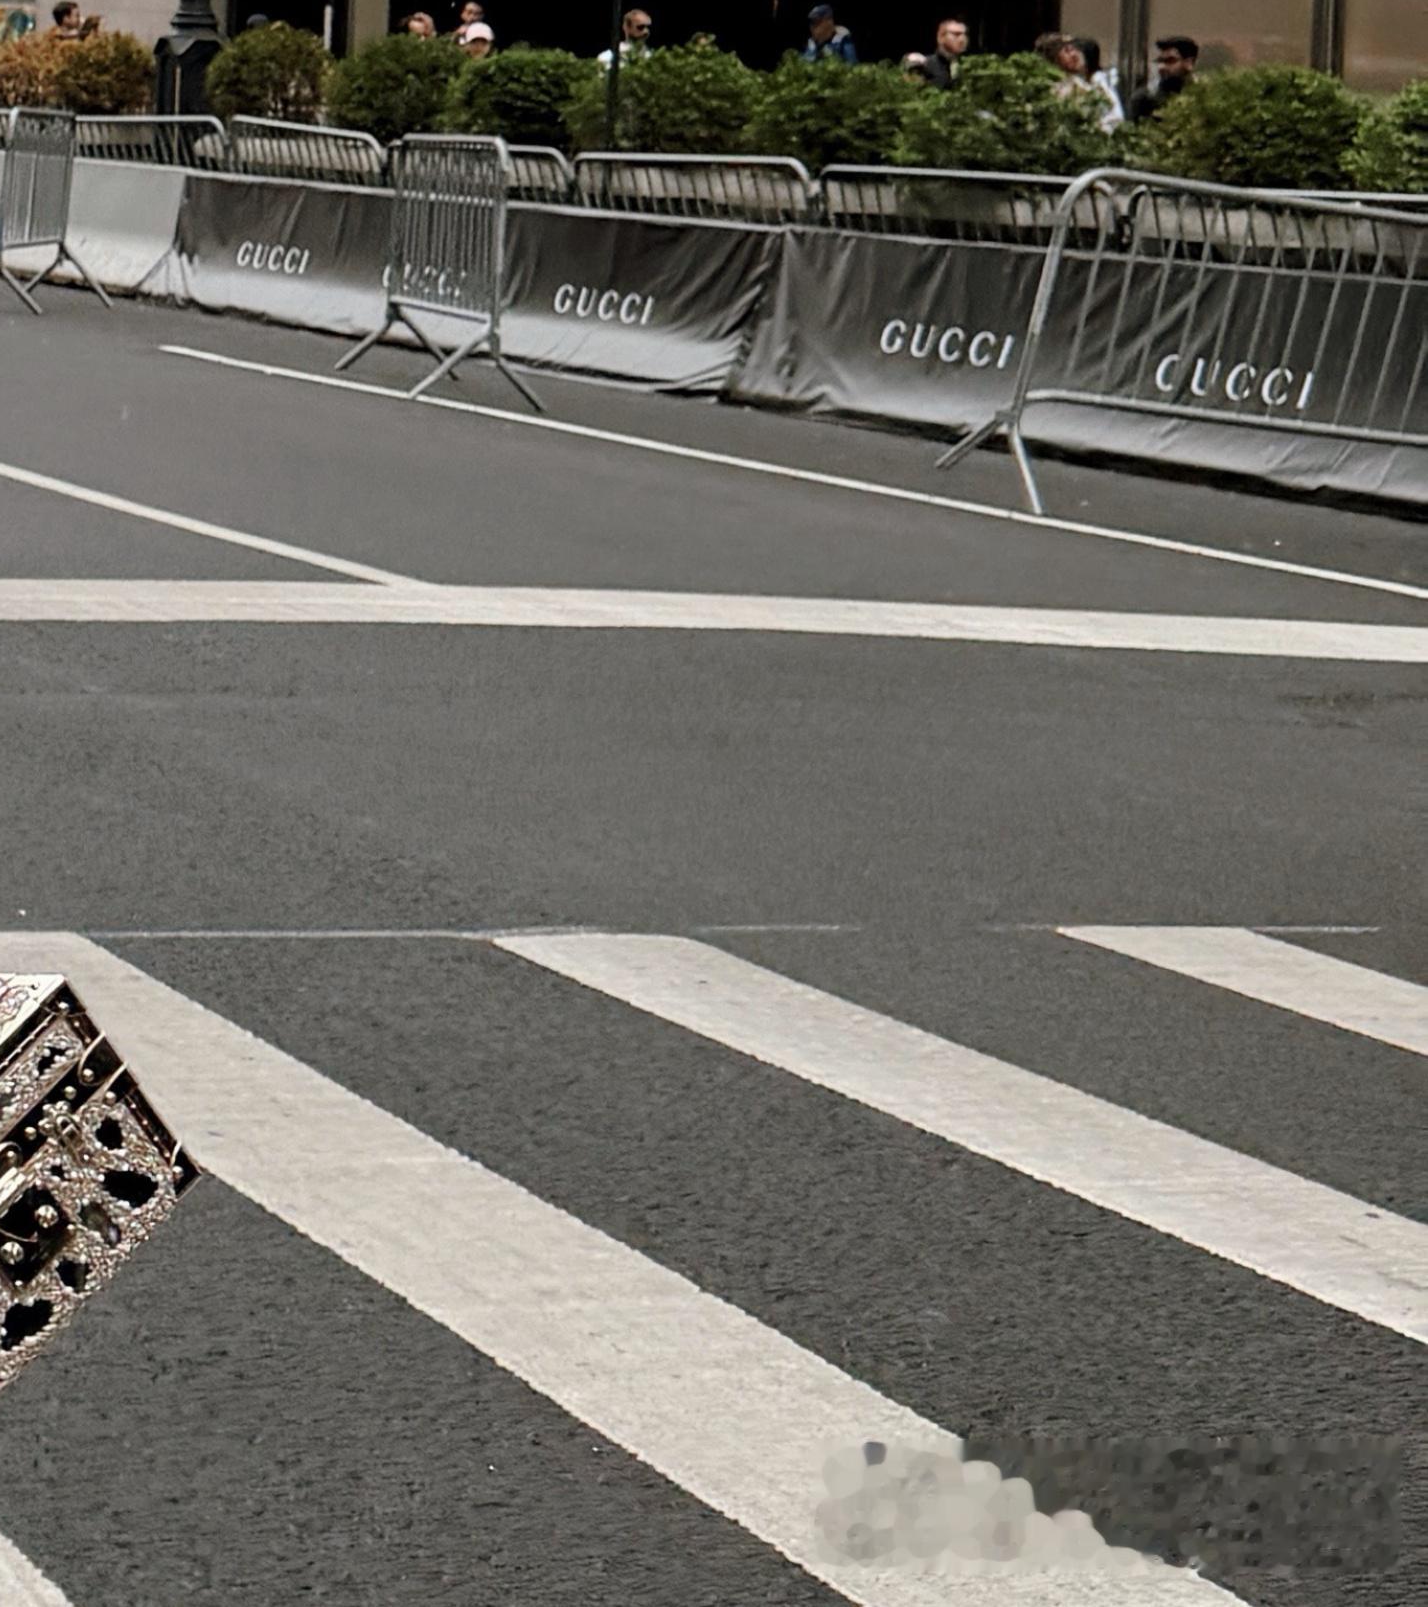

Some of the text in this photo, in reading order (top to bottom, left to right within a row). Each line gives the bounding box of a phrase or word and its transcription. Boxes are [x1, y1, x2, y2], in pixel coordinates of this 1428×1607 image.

[236, 241, 310, 275] GUCCI
[553, 283, 655, 326] GUCCI
[880, 318, 1015, 370] GUCCI
